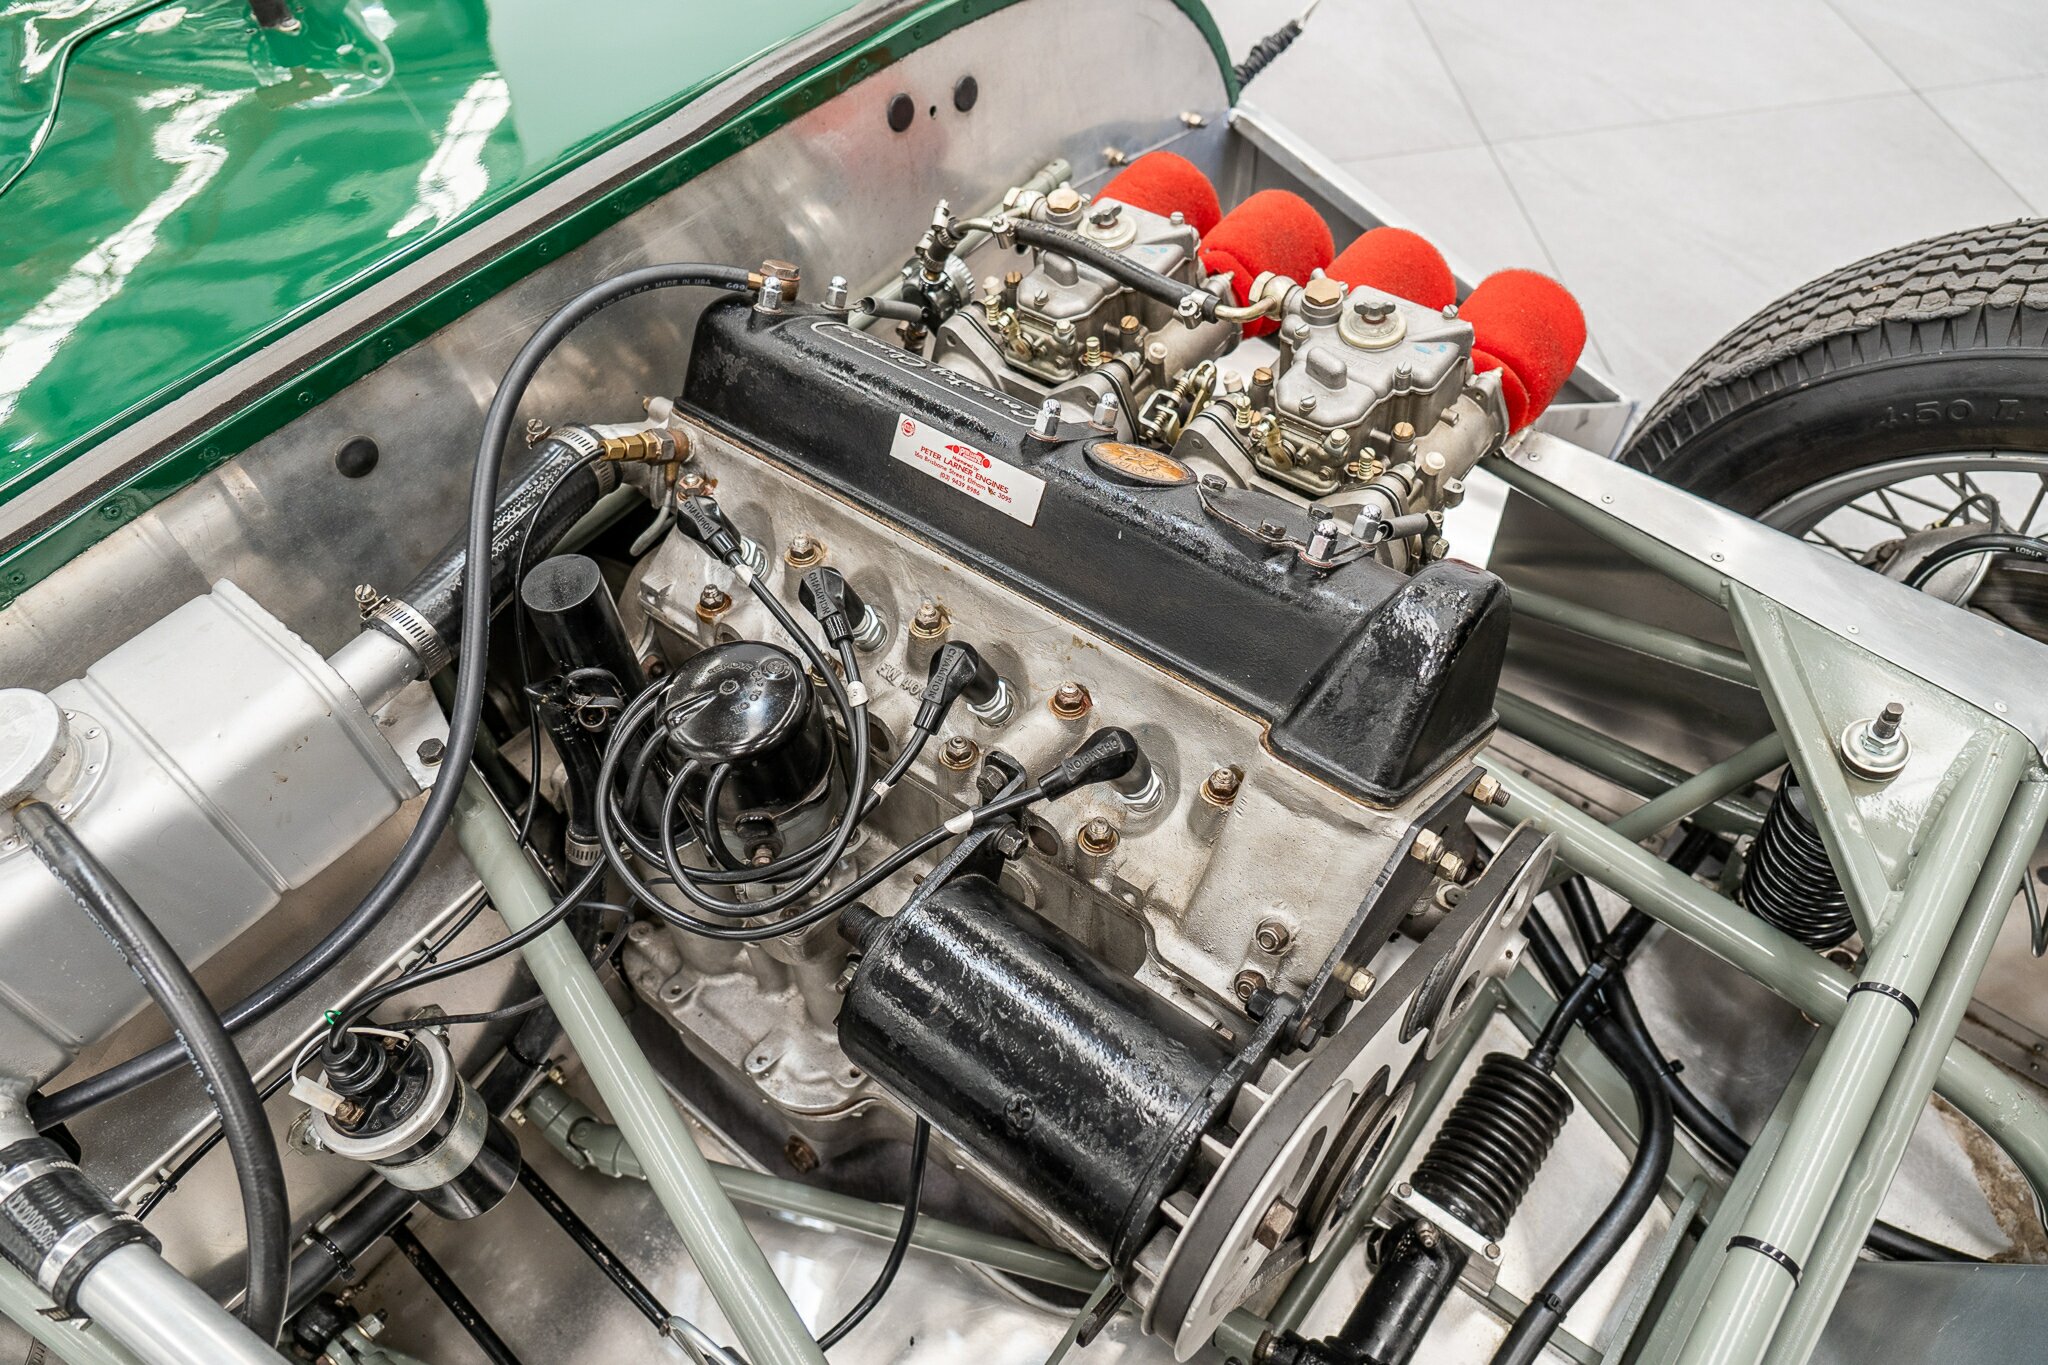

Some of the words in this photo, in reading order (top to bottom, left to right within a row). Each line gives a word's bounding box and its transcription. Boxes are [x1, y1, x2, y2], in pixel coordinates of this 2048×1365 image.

[655, 279, 678, 288] MADE
[695, 278, 711, 286] USA
[920, 445, 942, 461] PETER
[943, 457, 973, 476] LARNER
[975, 471, 1009, 494] ENGINES
[924, 455, 948, 472] Brisbane
[998, 492, 1012, 504] 3095
[939, 472, 950, 482] (03)
[951, 477, 965, 489] 9439
[684, 501, 714, 534] CHAMPION
[2015, 546, 2043, 558] J1401
[809, 572, 831, 615] CHAMPION
[708, 662, 753, 675] REMOVE
[928, 648, 957, 699] CHAMPION
[730, 701, 751, 714] OIL
[1065, 738, 1119, 773] CHAMPION
